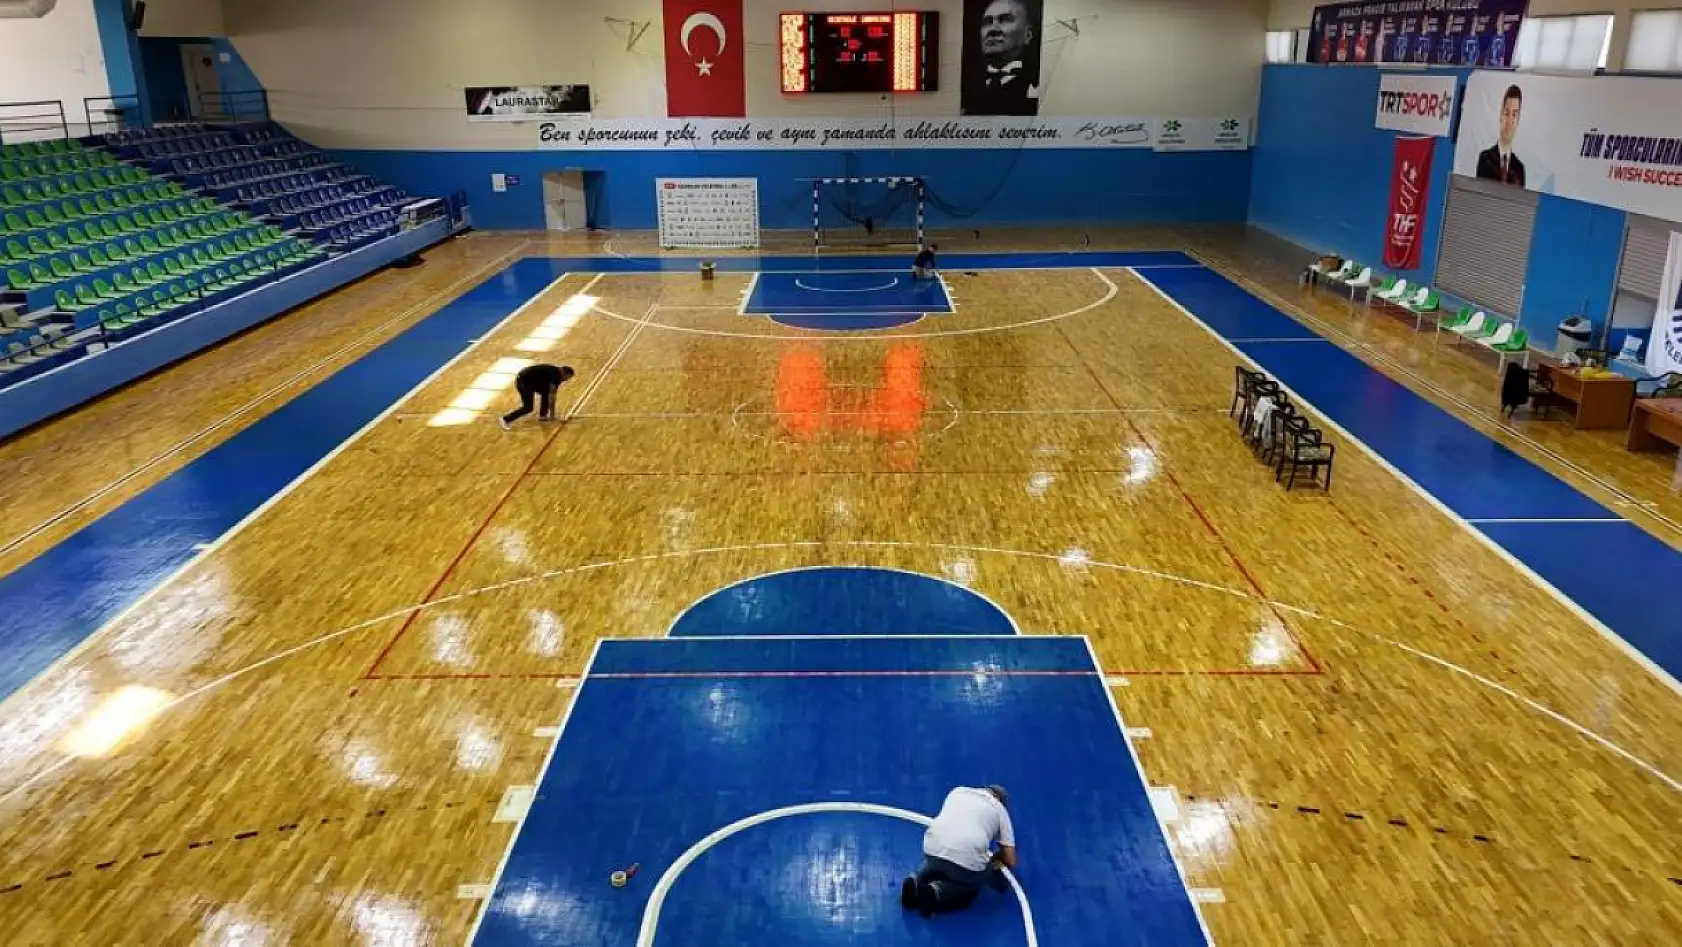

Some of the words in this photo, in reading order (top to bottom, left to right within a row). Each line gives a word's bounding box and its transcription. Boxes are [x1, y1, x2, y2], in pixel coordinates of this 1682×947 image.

[540, 122, 570, 141] Ben
[578, 127, 658, 145] sporcunun
[711, 123, 750, 145] çevik
[757, 129, 773, 140] ve
[821, 123, 896, 145] zamanda
[1580, 127, 1605, 157] TÜM
[1614, 165, 1643, 183] WISH
